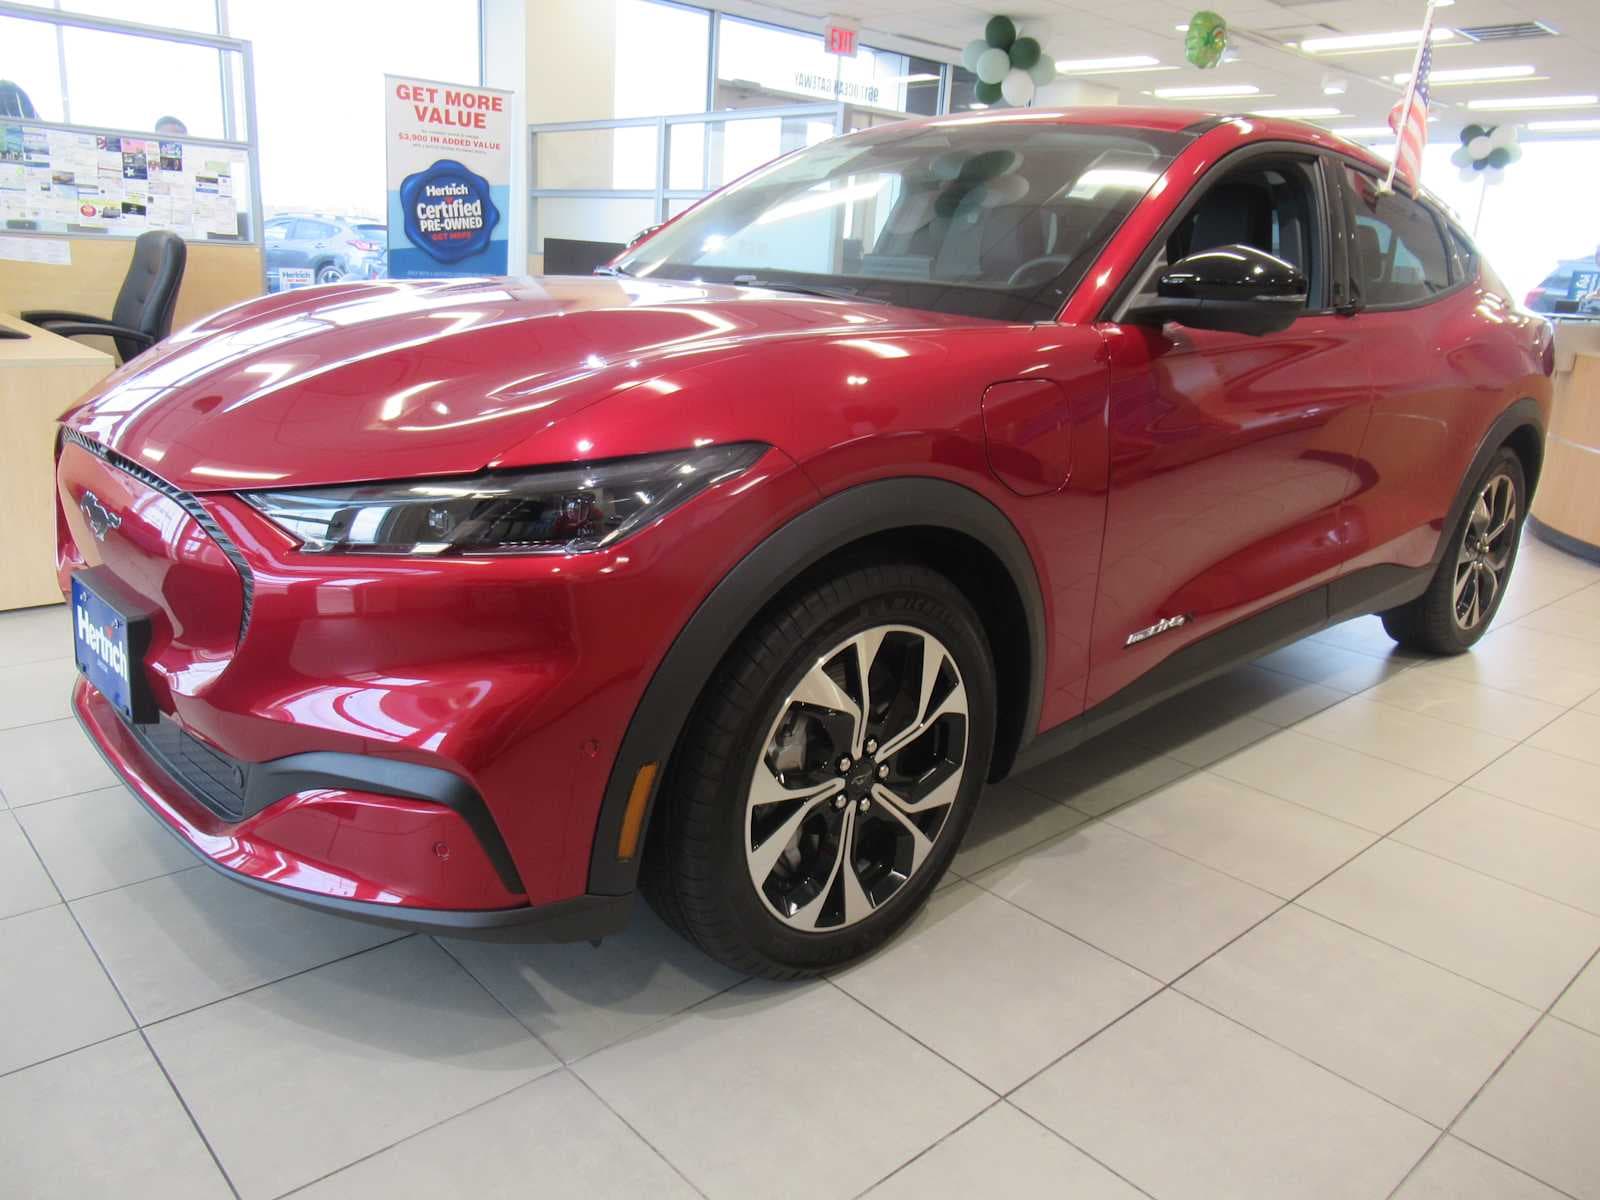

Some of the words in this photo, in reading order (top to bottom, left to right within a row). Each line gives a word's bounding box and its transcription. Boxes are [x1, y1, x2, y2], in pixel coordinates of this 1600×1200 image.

[830, 28, 855, 54] EXIT
[396, 84, 438, 104] GET
[445, 90, 503, 112] MORE
[414, 105, 487, 129] VALUE
[398, 132, 428, 142] $3,900
[442, 137, 471, 147] ADDED
[473, 140, 501, 150] VALUE
[426, 183, 469, 197] Hertrich
[416, 198, 482, 219] Certified
[420, 216, 483, 232] PRE-OWNED
[77, 605, 128, 680] Hertrich
